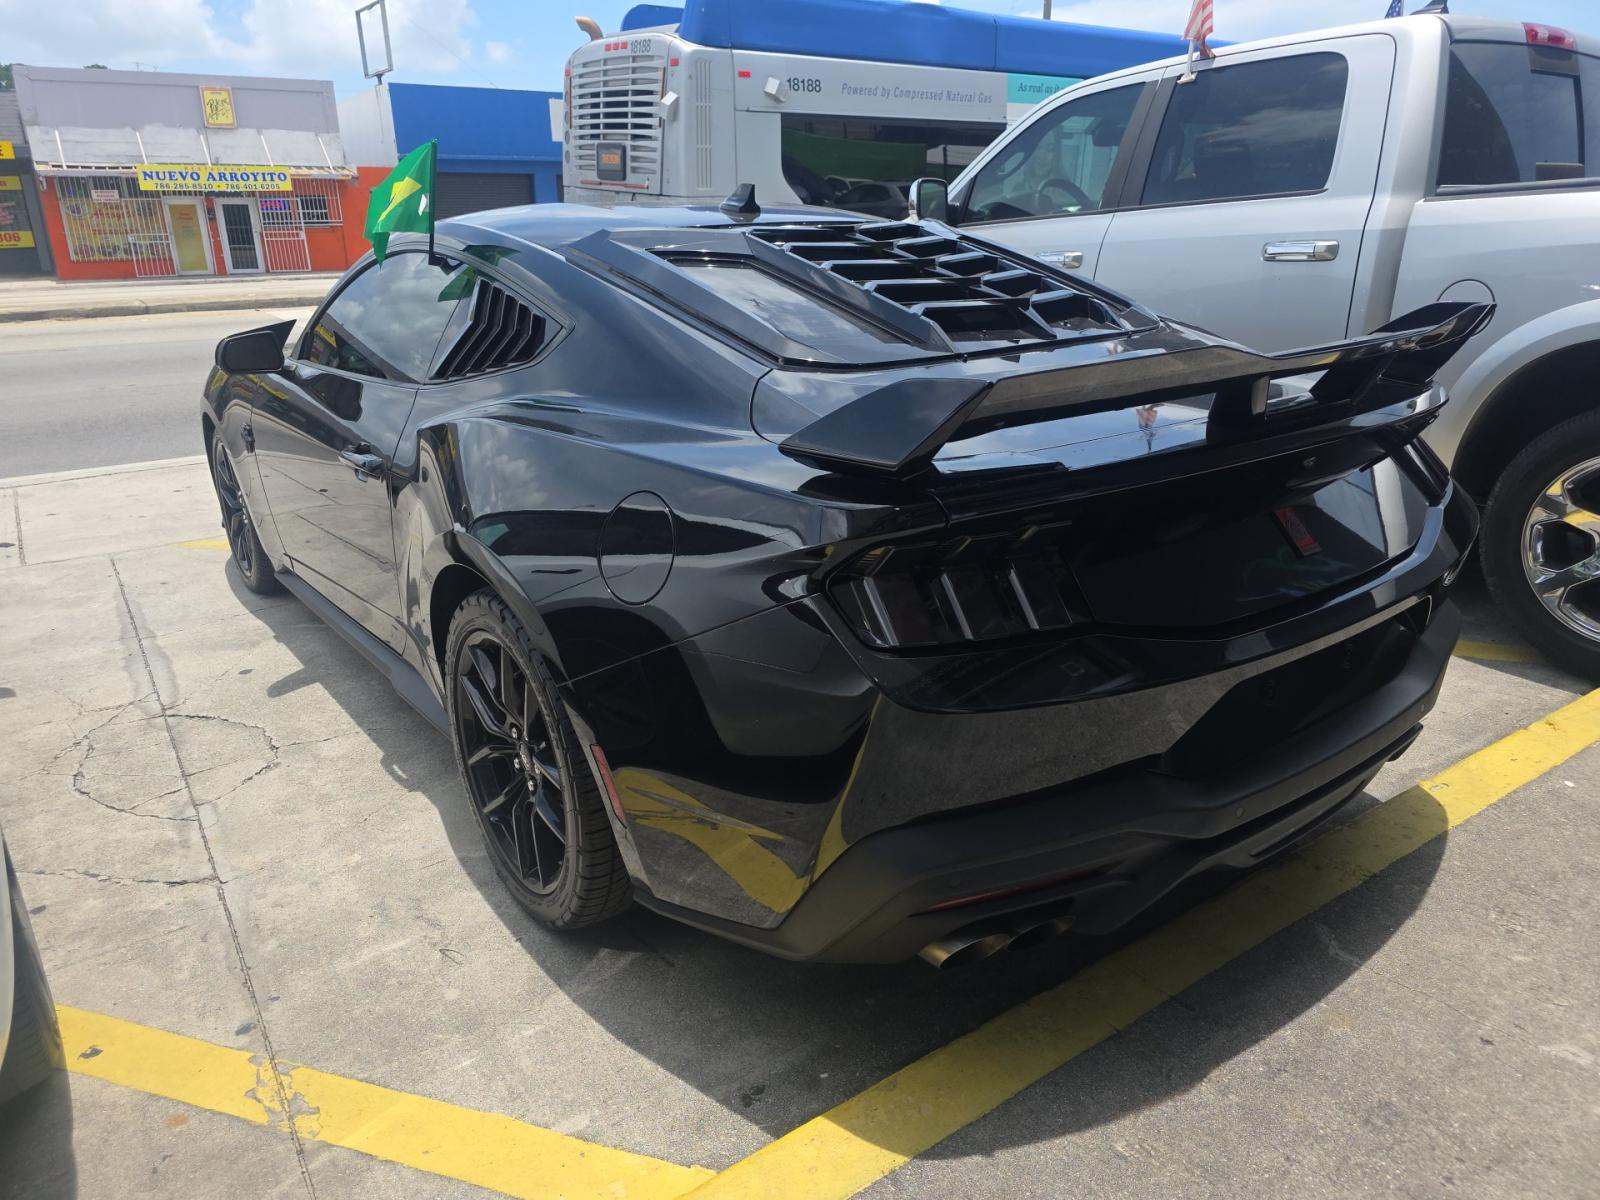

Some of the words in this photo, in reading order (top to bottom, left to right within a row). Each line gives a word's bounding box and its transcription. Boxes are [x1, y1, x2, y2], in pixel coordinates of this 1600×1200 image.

[631, 39, 651, 54] 18188
[787, 77, 822, 93] 18188
[842, 83, 879, 96] Powered
[880, 85, 892, 100] by
[894, 86, 944, 101] Compressed
[946, 89, 976, 104] Natural
[978, 92, 993, 104] Gas
[142, 170, 201, 182] NUEVO
[207, 171, 287, 182] ARROYITO
